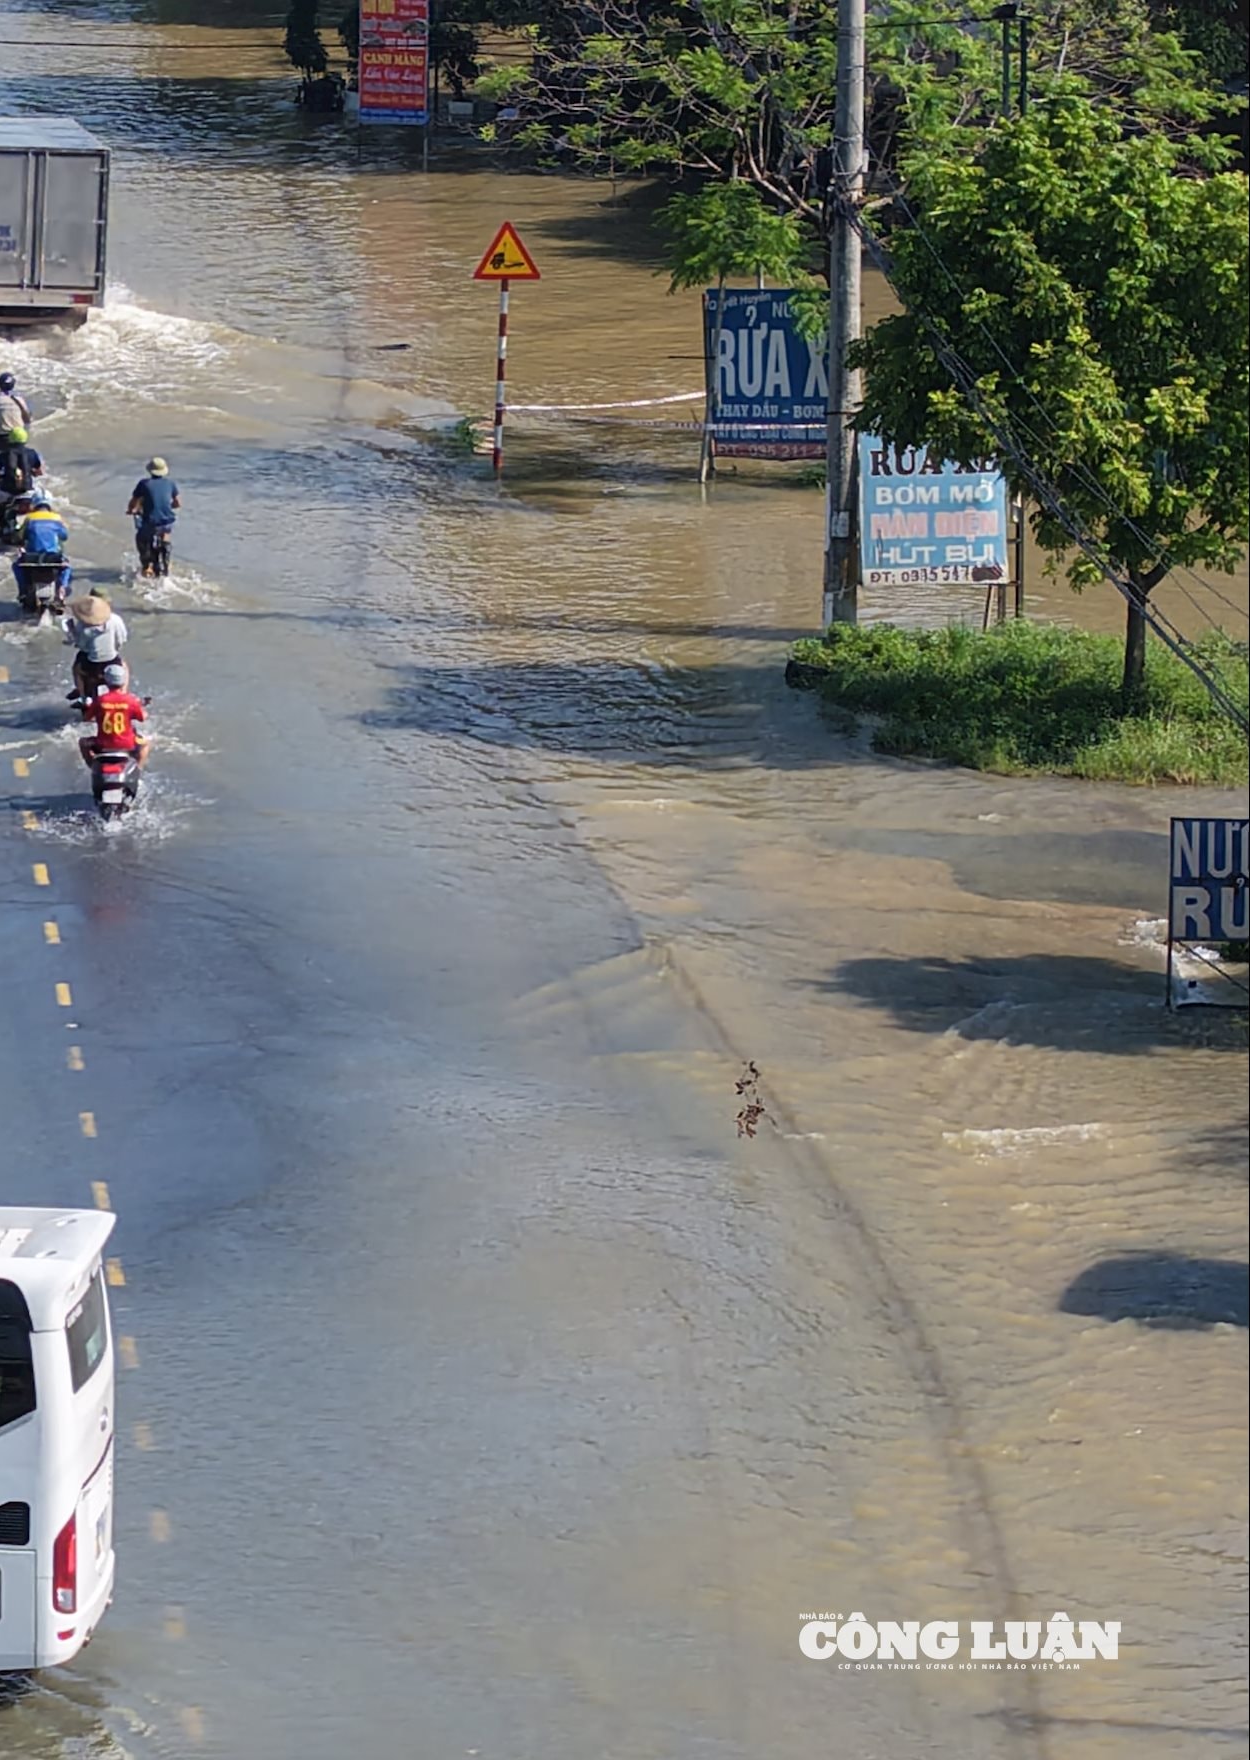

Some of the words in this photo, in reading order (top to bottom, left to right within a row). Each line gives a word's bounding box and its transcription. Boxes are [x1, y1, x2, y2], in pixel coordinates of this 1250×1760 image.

[711, 305, 790, 398] RỬA
[803, 333, 830, 398] X
[875, 482, 940, 505] BƠM
[102, 711, 126, 736] 68
